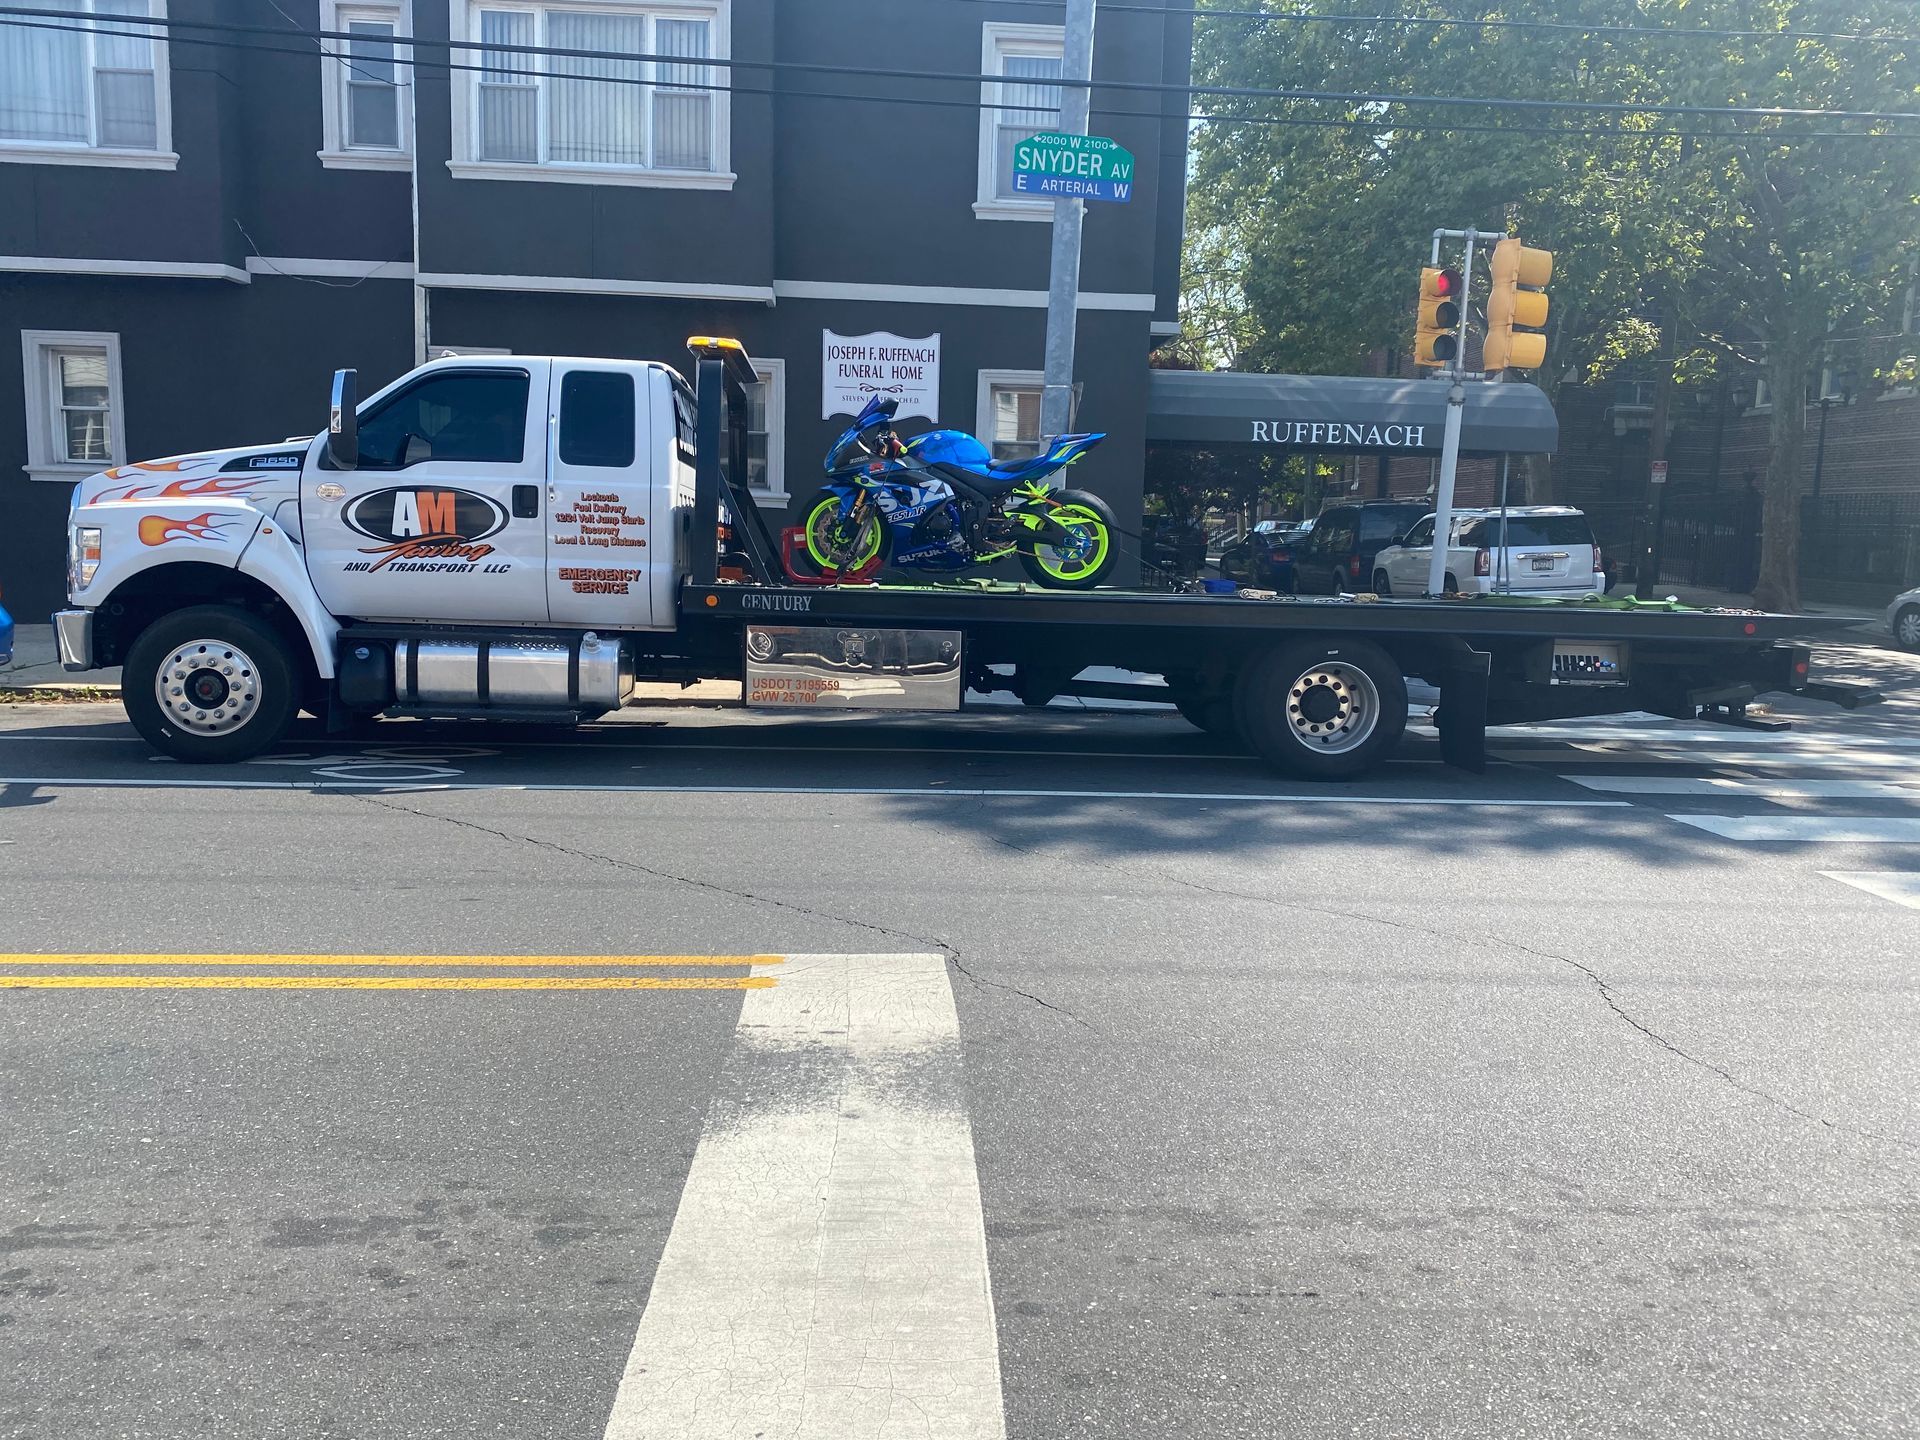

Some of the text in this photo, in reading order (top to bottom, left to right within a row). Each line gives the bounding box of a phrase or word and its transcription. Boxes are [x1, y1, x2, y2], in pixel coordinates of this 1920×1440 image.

[1041, 135, 1109, 150] 2000 W 2100
[1018, 146, 1130, 179] SNYDER AV
[1016, 174, 1129, 199] E ARTERIAL W
[827, 345, 935, 363] JOSEPH F. RUFFENACH
[838, 363, 923, 380] FUNERAL HOME
[842, 394, 865, 402] STEVEN
[1250, 420, 1425, 447] RUFFENACH
[580, 492, 620, 503] Lockouts
[391, 491, 457, 537] AM
[573, 502, 627, 516] Fuel Delivery
[555, 512, 646, 527] 12/24 Volt Jump Starts
[580, 524, 620, 538] Recovery
[554, 534, 647, 548] Local & Long Distance
[357, 533, 496, 574] Towing
[343, 562, 512, 574] AND TRANSPORT LLC
[558, 567, 642, 582] EMERGENCY
[571, 581, 630, 595] SERVICE
[741, 593, 812, 612] CENTURY
[752, 678, 840, 691] USDOT 3195559
[752, 690, 817, 704] GVW 25,700
